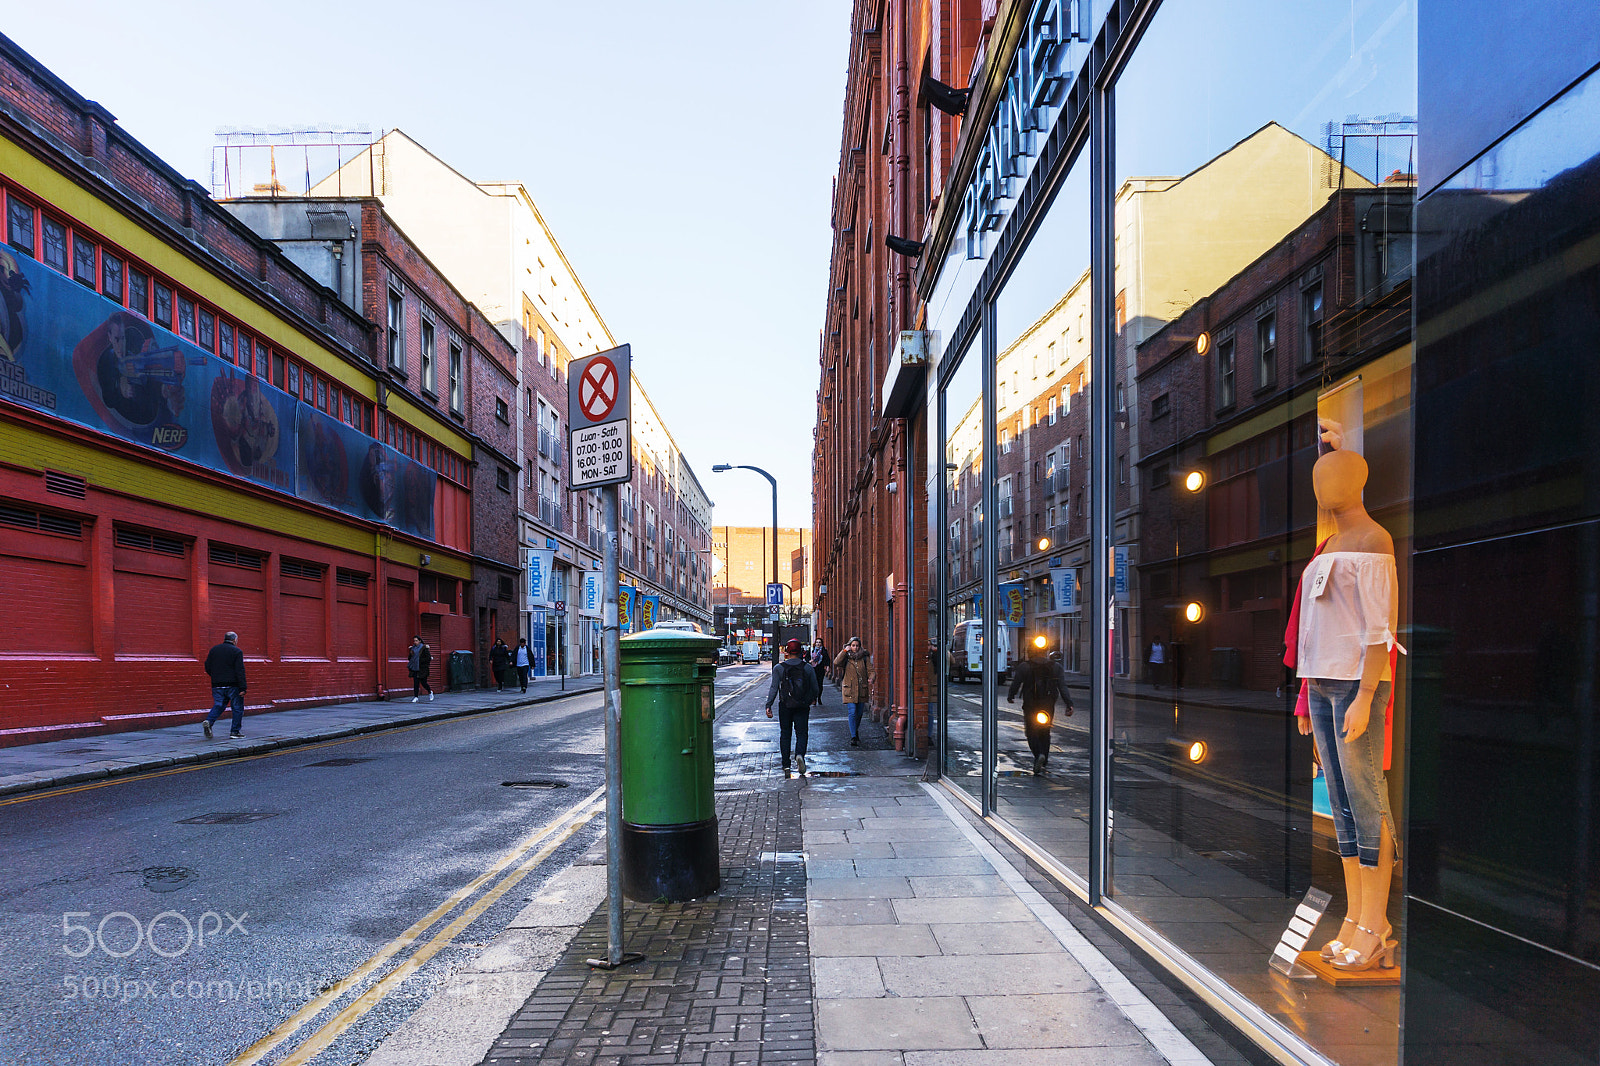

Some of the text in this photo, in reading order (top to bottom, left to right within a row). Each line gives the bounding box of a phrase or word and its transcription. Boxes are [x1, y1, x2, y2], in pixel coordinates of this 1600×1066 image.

[0, 375, 56, 410] ORMERS
[152, 427, 187, 444] NERF
[580, 433, 597, 442] Luan
[601, 426, 618, 438] Sath
[576, 443, 597, 456] 07.00
[602, 438, 622, 450] 10.00
[577, 456, 597, 468] 16.00
[602, 450, 623, 463] 19.00
[581, 468, 599, 480] MON
[603, 465, 617, 475] SAT
[529, 556, 542, 597] maplin
[585, 576, 597, 610] maplin
[768, 586, 776, 602] P
[619, 591, 629, 625] SMYTHS
[643, 599, 653, 630] SMYTHS
